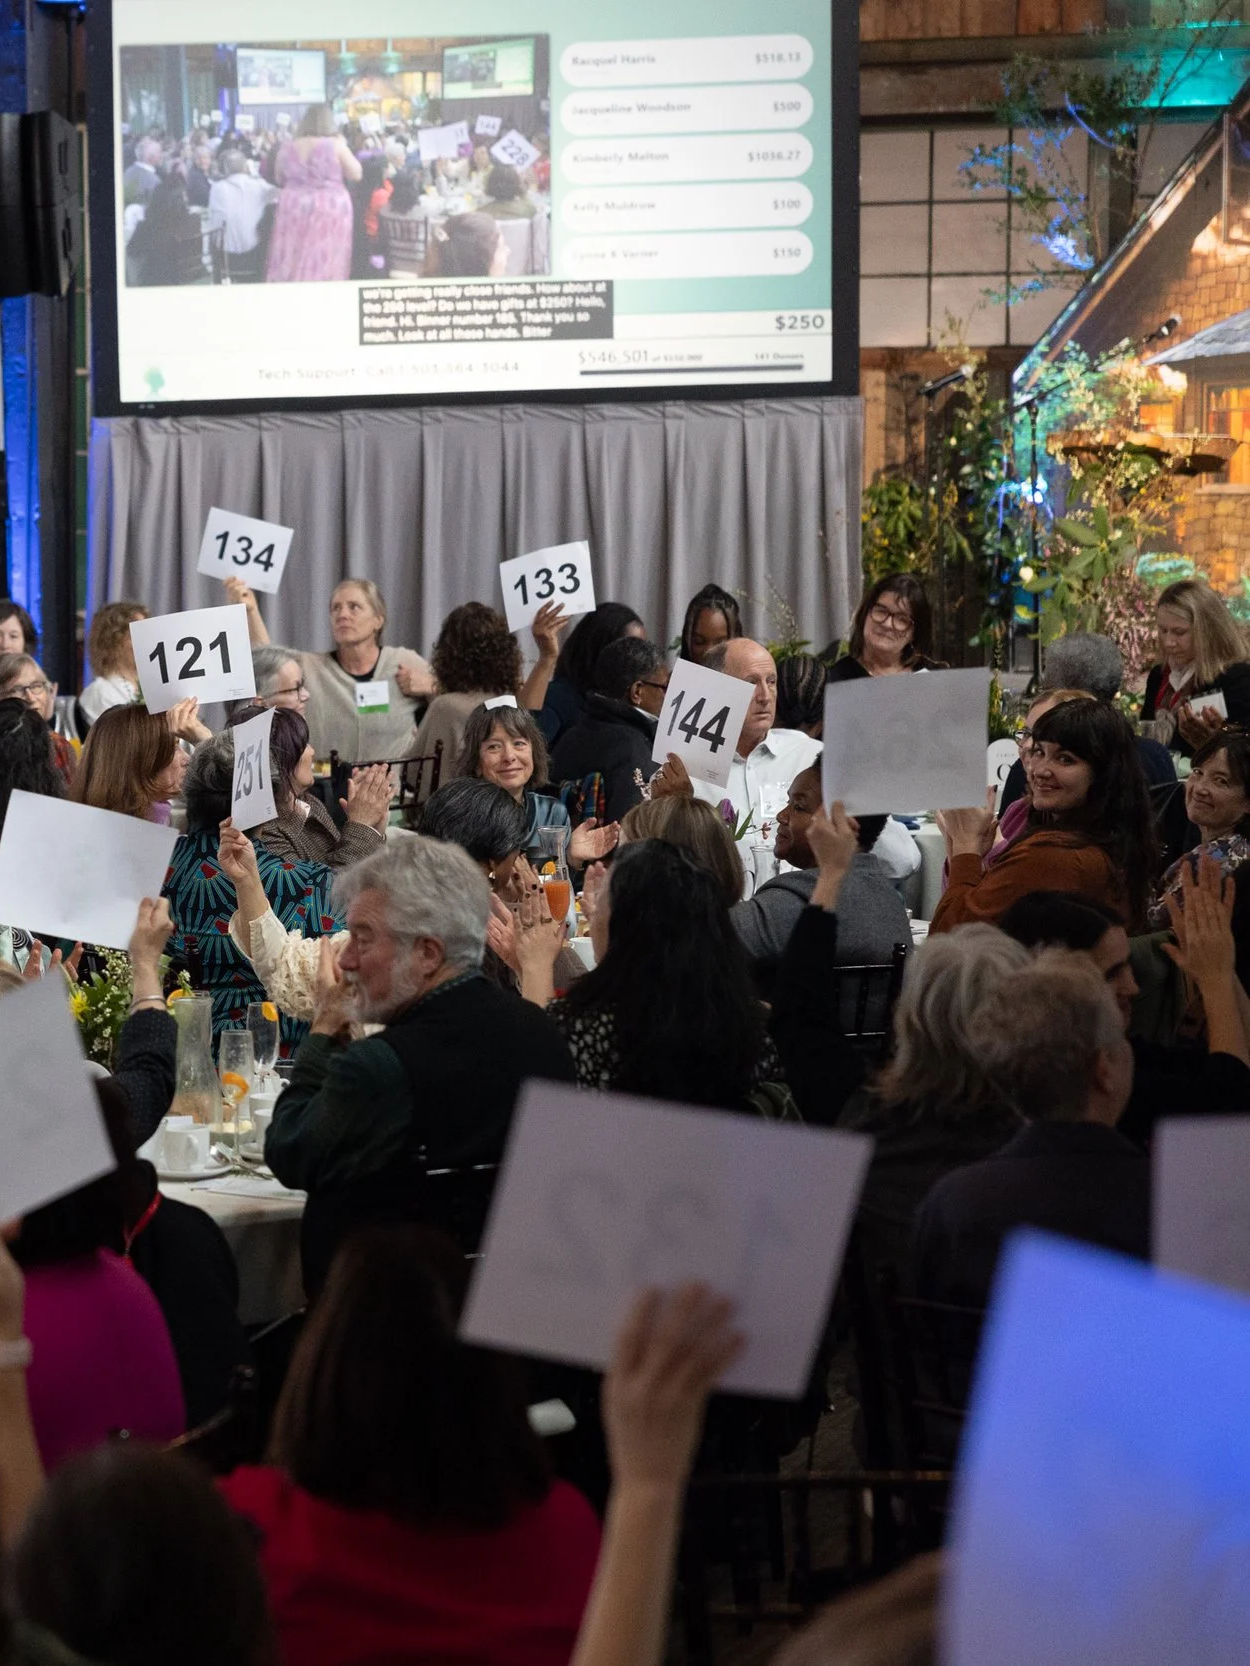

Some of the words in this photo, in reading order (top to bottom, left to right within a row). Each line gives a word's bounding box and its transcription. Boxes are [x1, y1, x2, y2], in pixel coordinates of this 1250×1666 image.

[621, 53, 656, 64] Harris
[773, 101, 801, 112] $500
[502, 140, 530, 166] 228
[772, 199, 801, 211] $100
[772, 248, 801, 259] $150
[393, 287, 432, 301] getting
[433, 285, 463, 299] really
[536, 283, 561, 295] How
[561, 281, 593, 294] about
[595, 281, 607, 293] at
[472, 298, 499, 311] have
[526, 297, 538, 309] at
[520, 311, 553, 324] Thank
[554, 311, 575, 325] you
[775, 314, 825, 331] $250
[257, 368, 292, 381] Tech
[215, 530, 275, 573] 134
[513, 562, 581, 606] 133
[149, 631, 231, 684] 121
[667, 690, 731, 753] 144
[234, 738, 263, 802] 251
